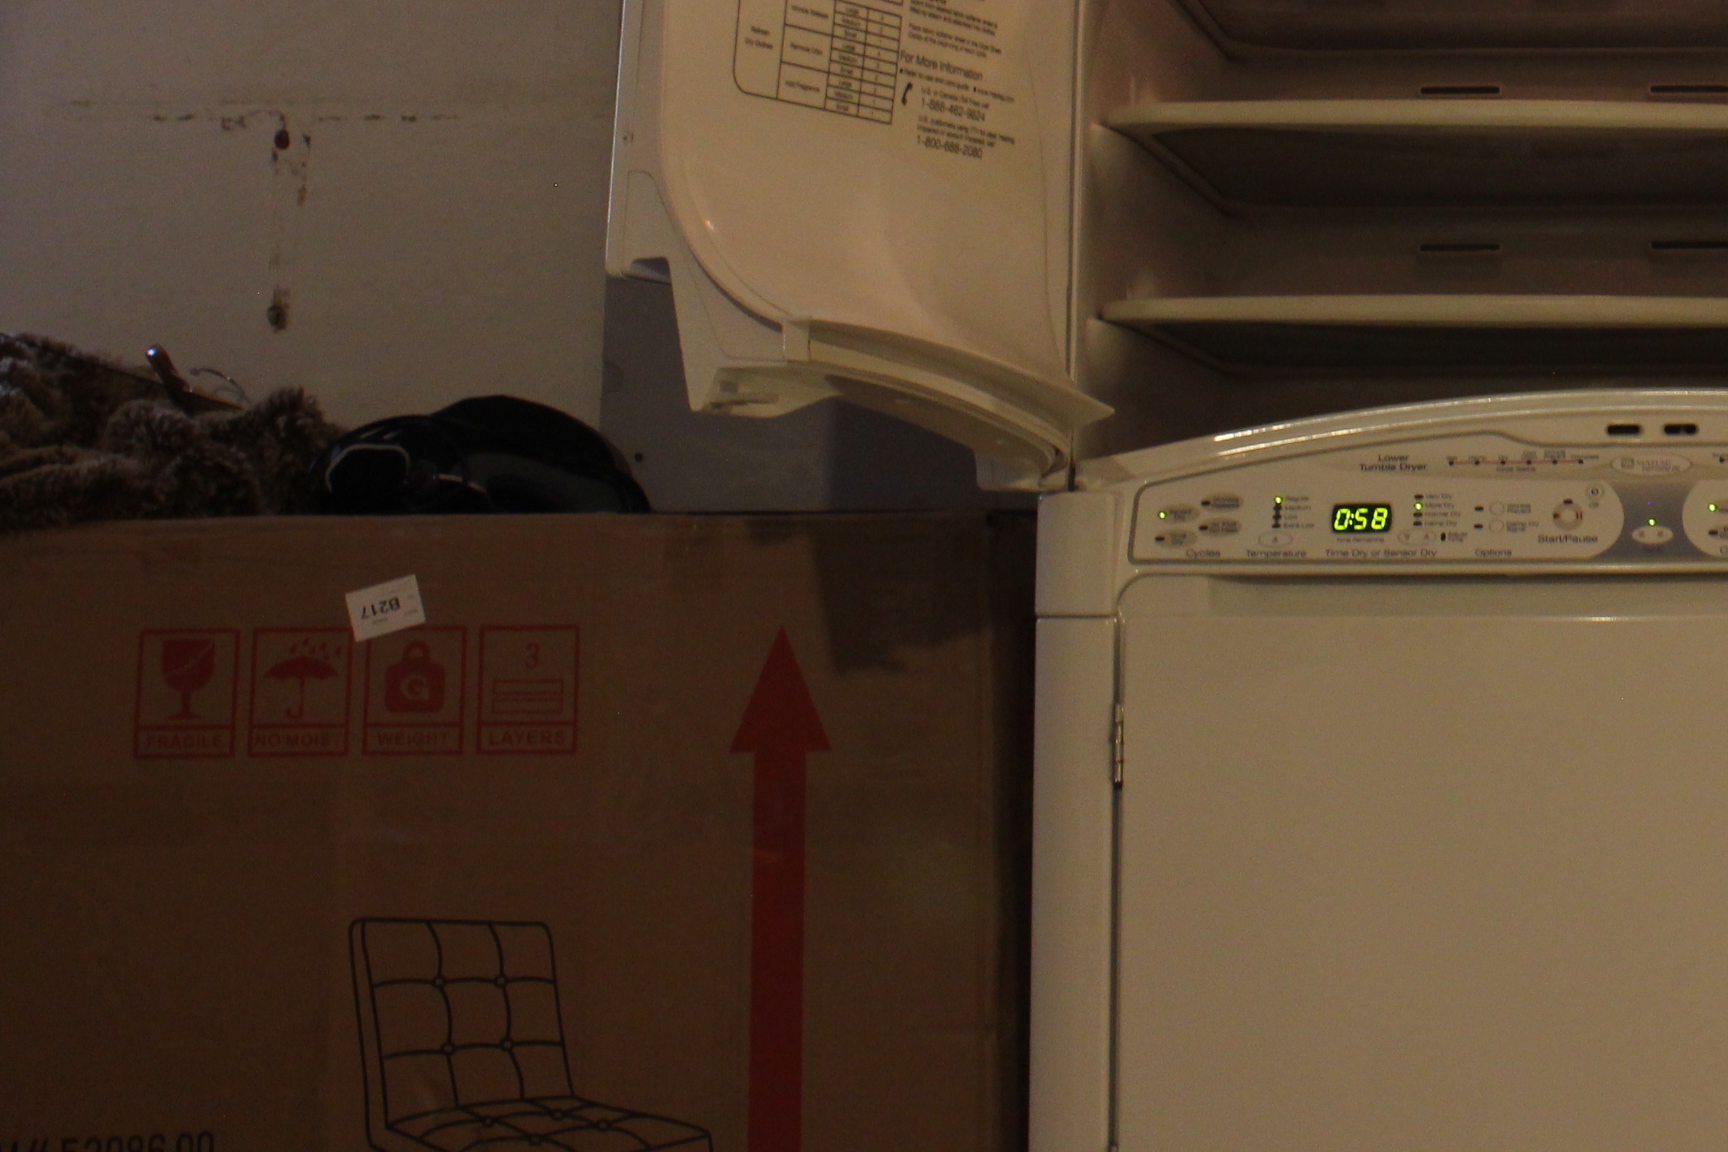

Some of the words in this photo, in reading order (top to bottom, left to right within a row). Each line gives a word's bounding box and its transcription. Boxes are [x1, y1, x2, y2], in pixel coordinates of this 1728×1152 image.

[1378, 454, 1409, 462] Lower
[1360, 462, 1397, 472] Tumble
[1399, 462, 1428, 472] Dryer
[1333, 507, 1388, 531] 0:58
[1537, 534, 1599, 543] Start/Pause
[1185, 549, 1221, 559] Cycles
[1247, 548, 1307, 558] Temperature
[1325, 548, 1349, 557] Time
[1351, 548, 1369, 559] Dry
[1420, 548, 1438, 558] Dry
[1474, 548, 1513, 558] Options
[361, 597, 400, 620] B217
[525, 641, 540, 670] 3
[146, 733, 223, 748] FRAGILE
[255, 733, 281, 748] NO
[378, 731, 448, 747] WEIGHT
[488, 729, 567, 746] LAYERS
